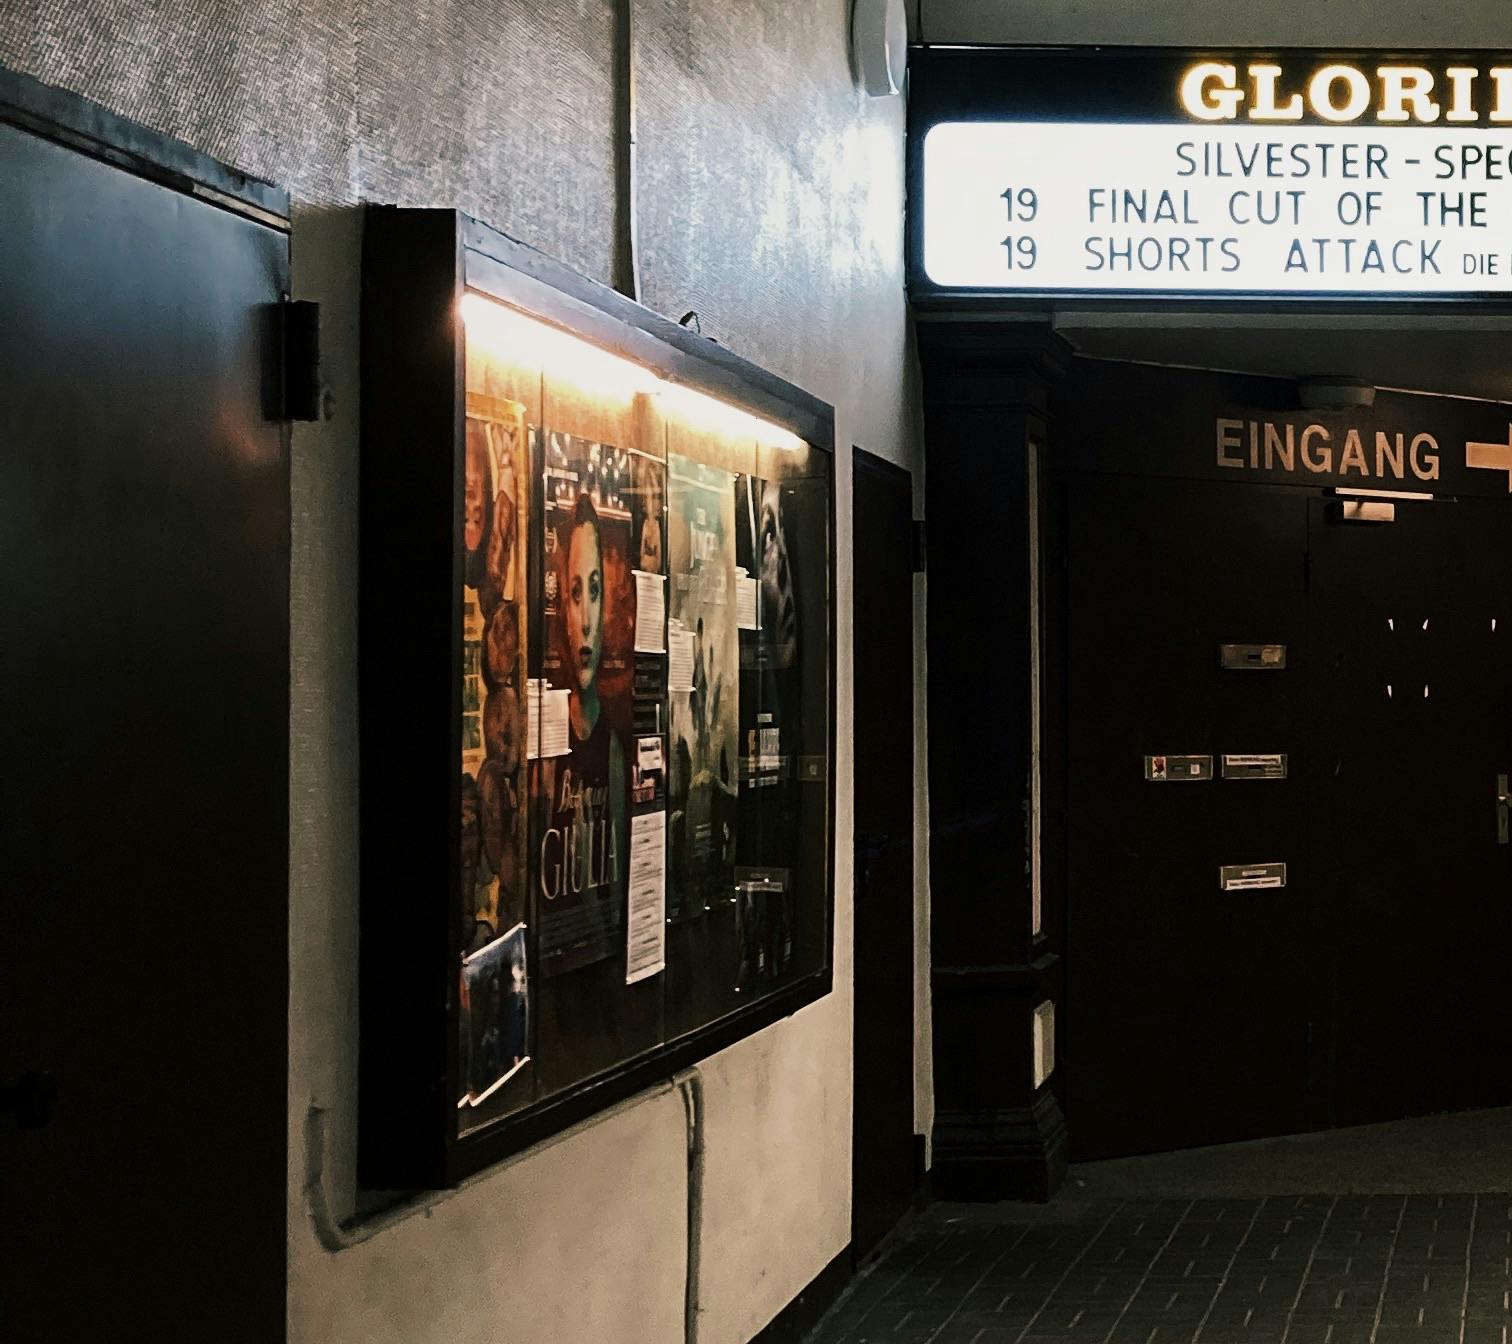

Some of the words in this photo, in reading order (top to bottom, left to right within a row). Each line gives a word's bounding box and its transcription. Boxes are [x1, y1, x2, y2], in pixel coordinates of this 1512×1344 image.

[1176, 142, 1389, 178] SILVESTER
[1000, 187, 1038, 222] 19
[1089, 189, 1199, 224] FINAL
[1229, 191, 1306, 225] CUT
[1337, 191, 1383, 226] OF
[1416, 191, 1488, 227] THE
[1000, 235, 1037, 270] 19
[1084, 237, 1241, 272] SHORTS
[1284, 238, 1442, 274] ATTACK
[1463, 253, 1499, 275] DIE
[1216, 418, 1440, 481] EINGANG
